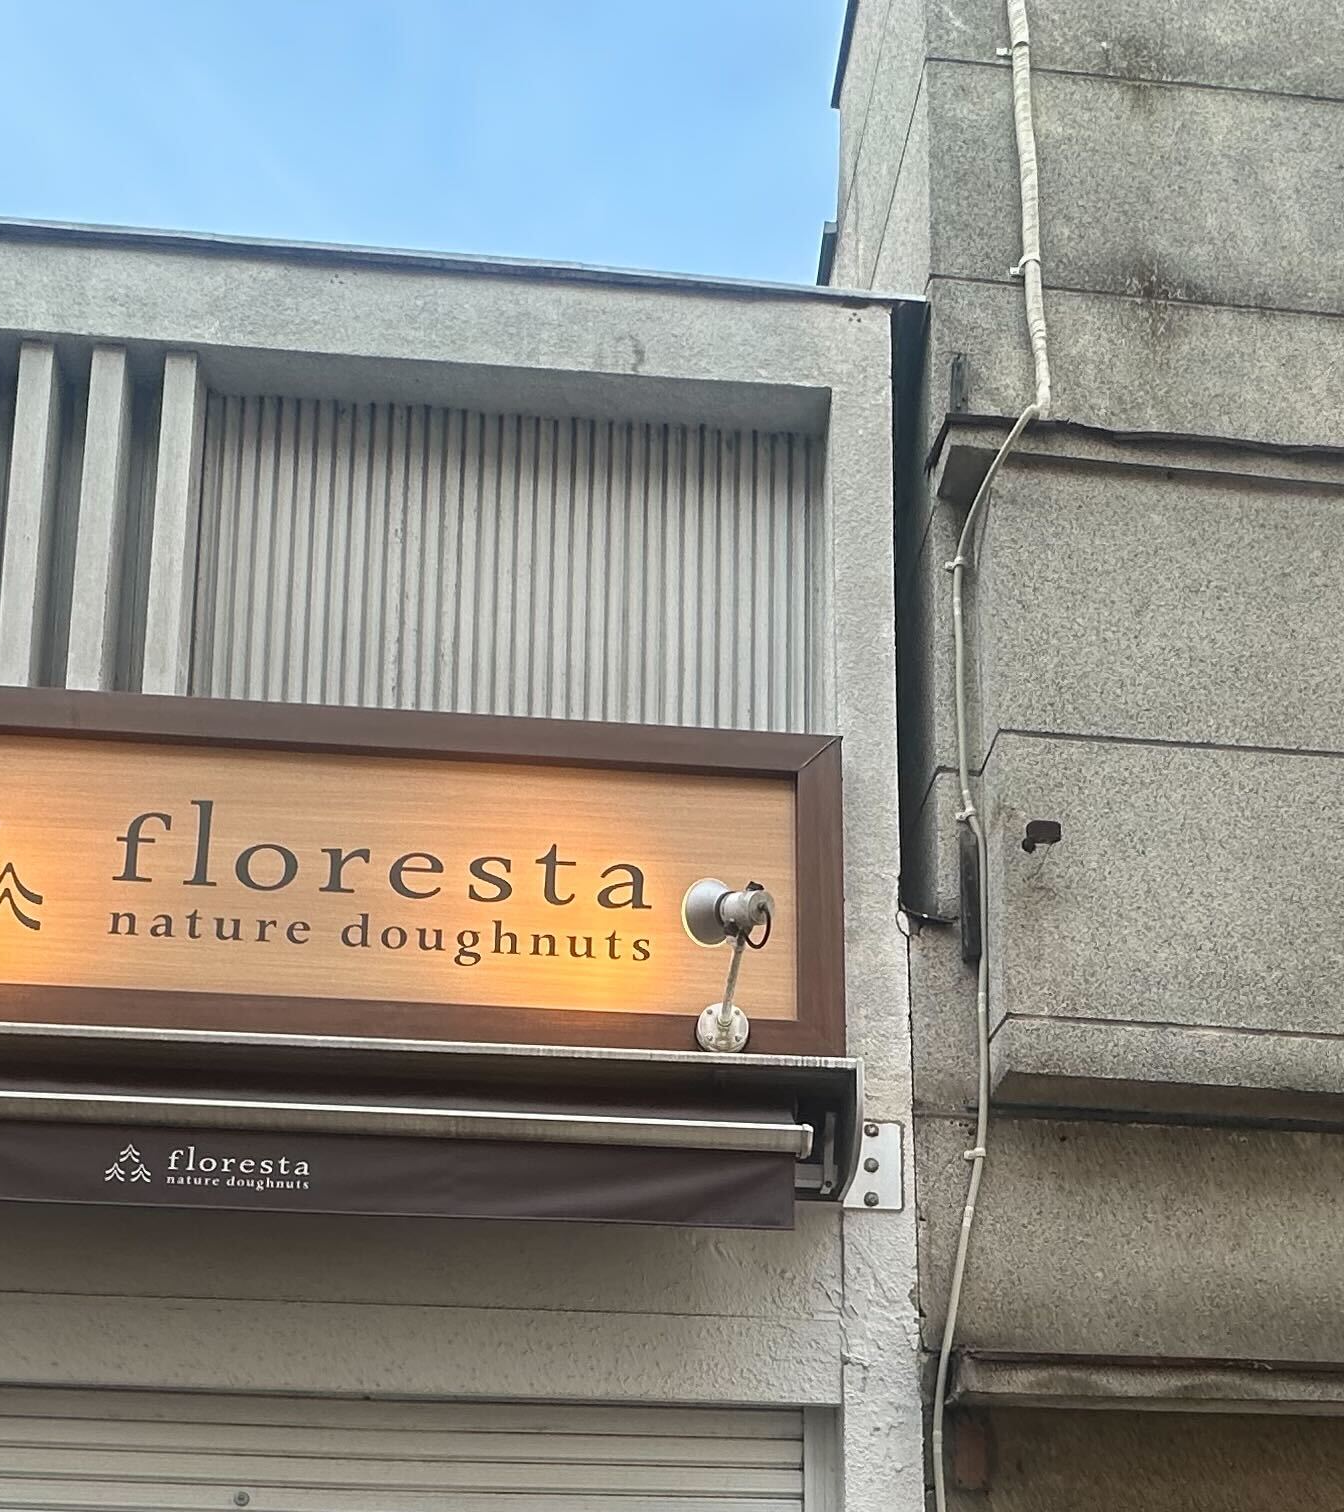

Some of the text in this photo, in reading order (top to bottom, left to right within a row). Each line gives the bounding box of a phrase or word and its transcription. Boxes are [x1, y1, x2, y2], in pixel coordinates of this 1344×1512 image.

[112, 800, 652, 910] floresta
[108, 909, 652, 966] nature doughnuts
[167, 1146, 310, 1176] floresta
[166, 1175, 310, 1191] nature doughnuts
